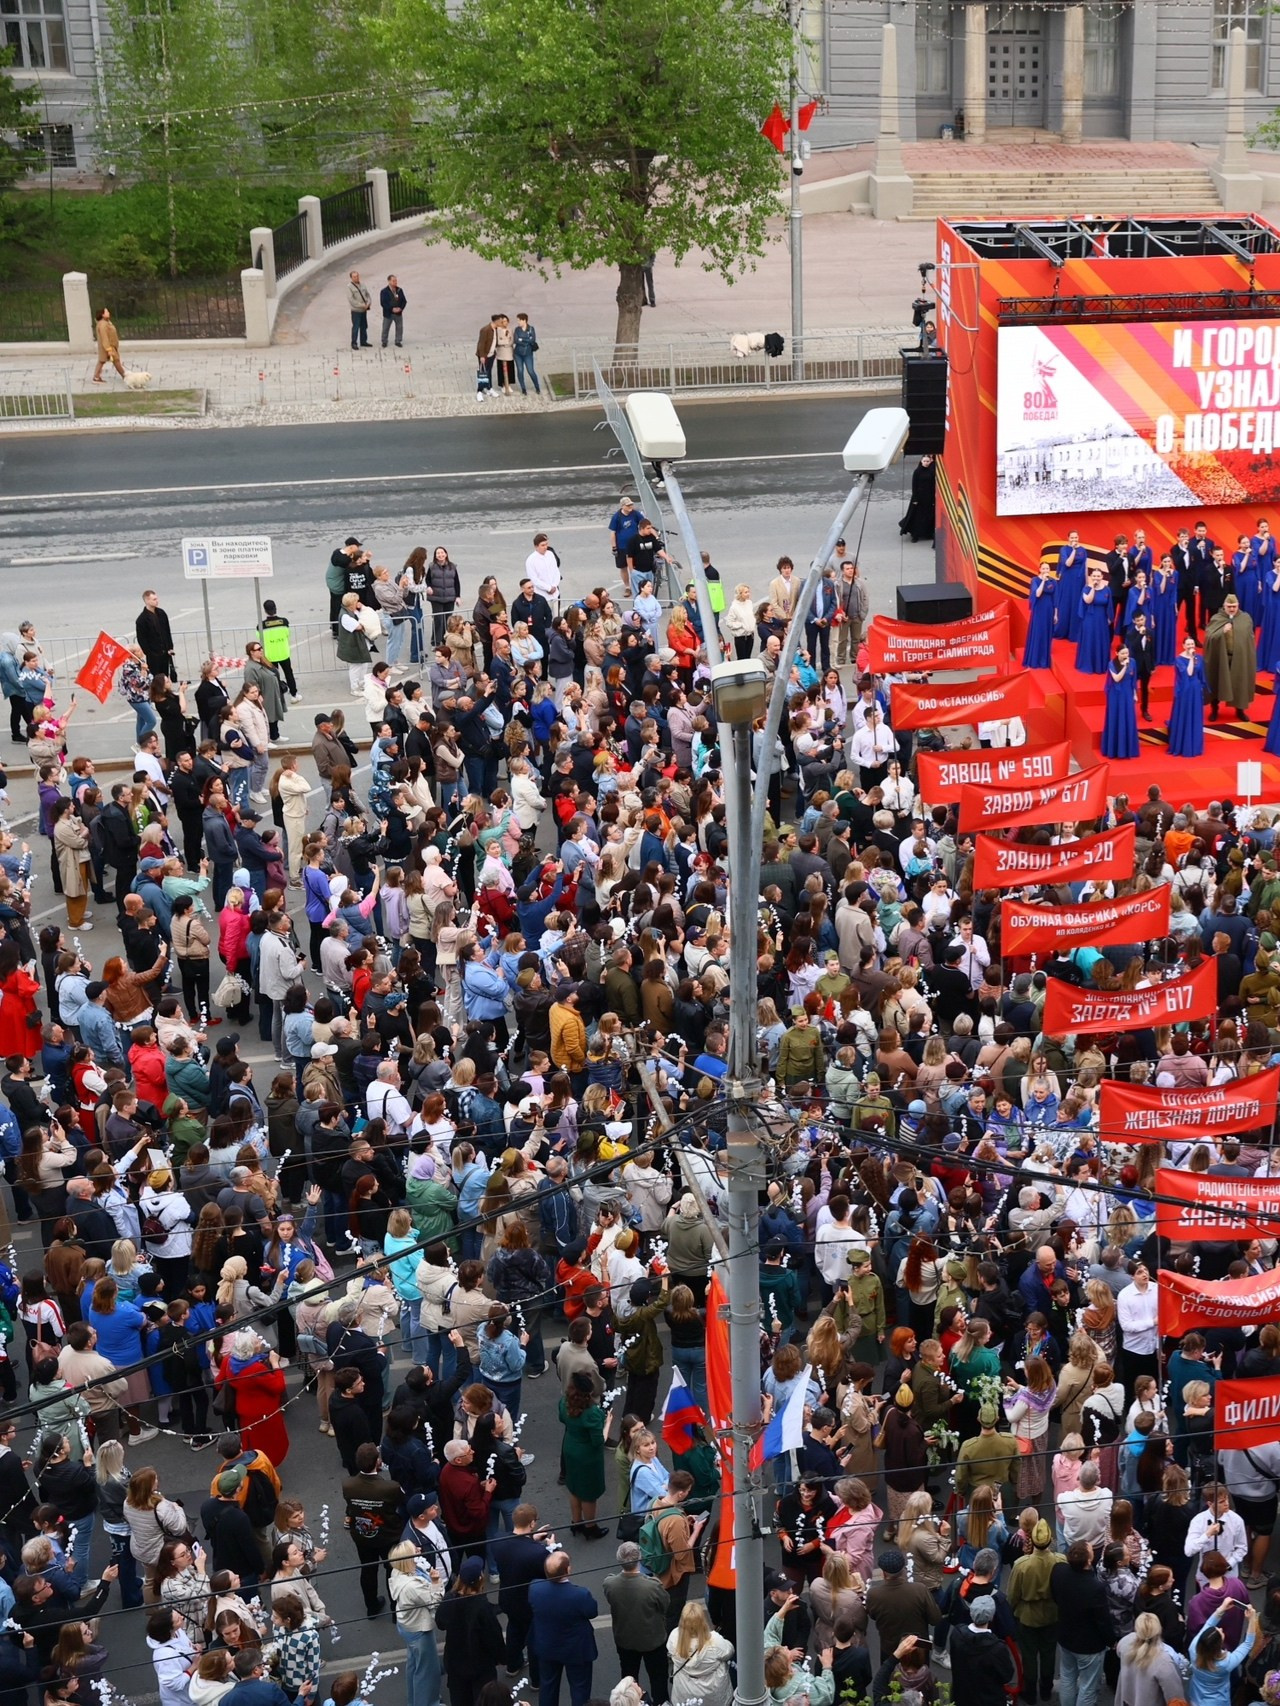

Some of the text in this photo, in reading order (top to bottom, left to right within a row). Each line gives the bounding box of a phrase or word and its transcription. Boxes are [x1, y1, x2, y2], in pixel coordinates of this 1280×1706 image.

[1173, 329, 1192, 368] И
[1023, 411, 1058, 421] ПОБЕДА!
[1156, 415, 1175, 453] О
[193, 550, 204, 565] P
[918, 691, 1005, 711] ОАО «СТАНКОСИБ»
[939, 755, 1053, 786] ЗАВОД № 590
[982, 791, 1033, 815] ЗАВОД
[1039, 789, 1057, 806] №
[997, 850, 1050, 871] ЗАВОД
[1084, 841, 1113, 865] 520
[1010, 900, 1161, 928] ОБУВНАЯ ФАБРИКА «КОРС»
[1071, 1004, 1130, 1024] ЗАВОД
[1165, 985, 1193, 1012] 617
[1161, 1088, 1225, 1107] ТОМСКАЯ
[1124, 1099, 1260, 1131] ЖЕЛЕЗНАЯ ДОРОГА
[1178, 1200, 1247, 1229] ЗАВОД
[1256, 1200, 1280, 1226] №
[1181, 1301, 1271, 1318] СТРЕЛОЧНЫЙ
